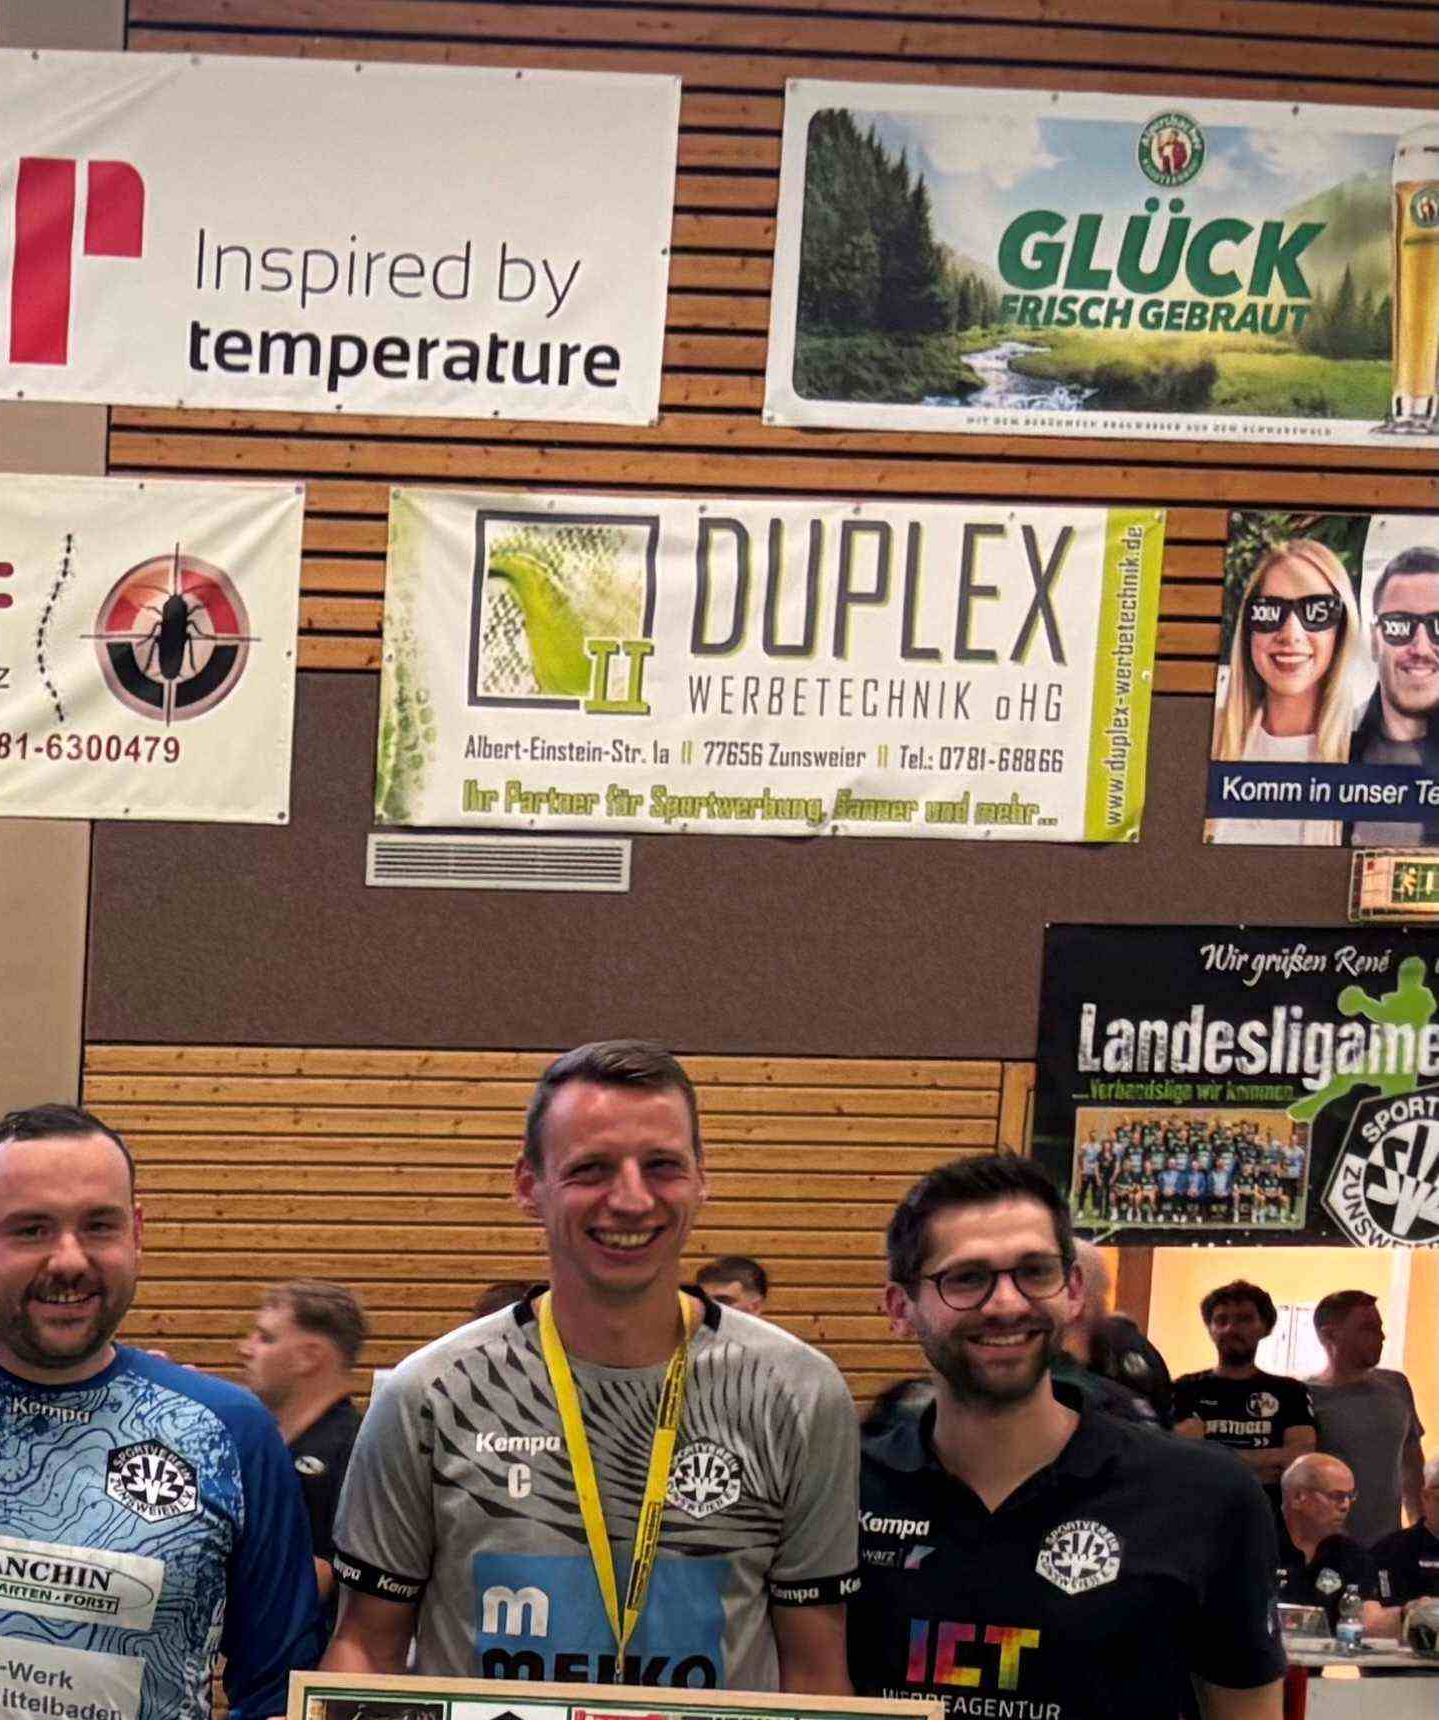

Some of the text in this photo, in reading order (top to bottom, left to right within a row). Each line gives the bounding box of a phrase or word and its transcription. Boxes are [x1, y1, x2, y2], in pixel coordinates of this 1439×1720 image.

[996, 197, 1327, 298] GLÜCK
[195, 228, 581, 318] Inspired by
[998, 294, 1311, 335] FRISCH GEBRAUT
[189, 320, 621, 392] temperature
[690, 515, 1075, 668] DUPLEX
[1104, 524, 1143, 827] www.duplex-werbetechnik.de
[687, 675, 1065, 723] WERBETECHNIK oHG
[463, 734, 646, 766] Albert-Einstein-Str.
[704, 740, 764, 768] 77656
[768, 744, 867, 770] Zunsweier
[899, 745, 934, 771] Tel.:
[939, 746, 1065, 774] 0781-68866
[462, 778, 1058, 827] Ihr Partner für Sportwerbung, Banner und mehr...
[1222, 775, 1302, 803] Komm
[1309, 776, 1331, 802] in
[1338, 782, 1409, 804] unser
[1200, 943, 1392, 987] Wir grüßen René
[1077, 1001, 1439, 1091] Landesligame
[11, 1396, 92, 1425] Kempa
[475, 1431, 561, 1455] Kempa
[507, 1463, 532, 1499] C
[862, 1550, 897, 1563] warz
[62, 1594, 117, 1614] FORST
[906, 1617, 1040, 1690] ICT
